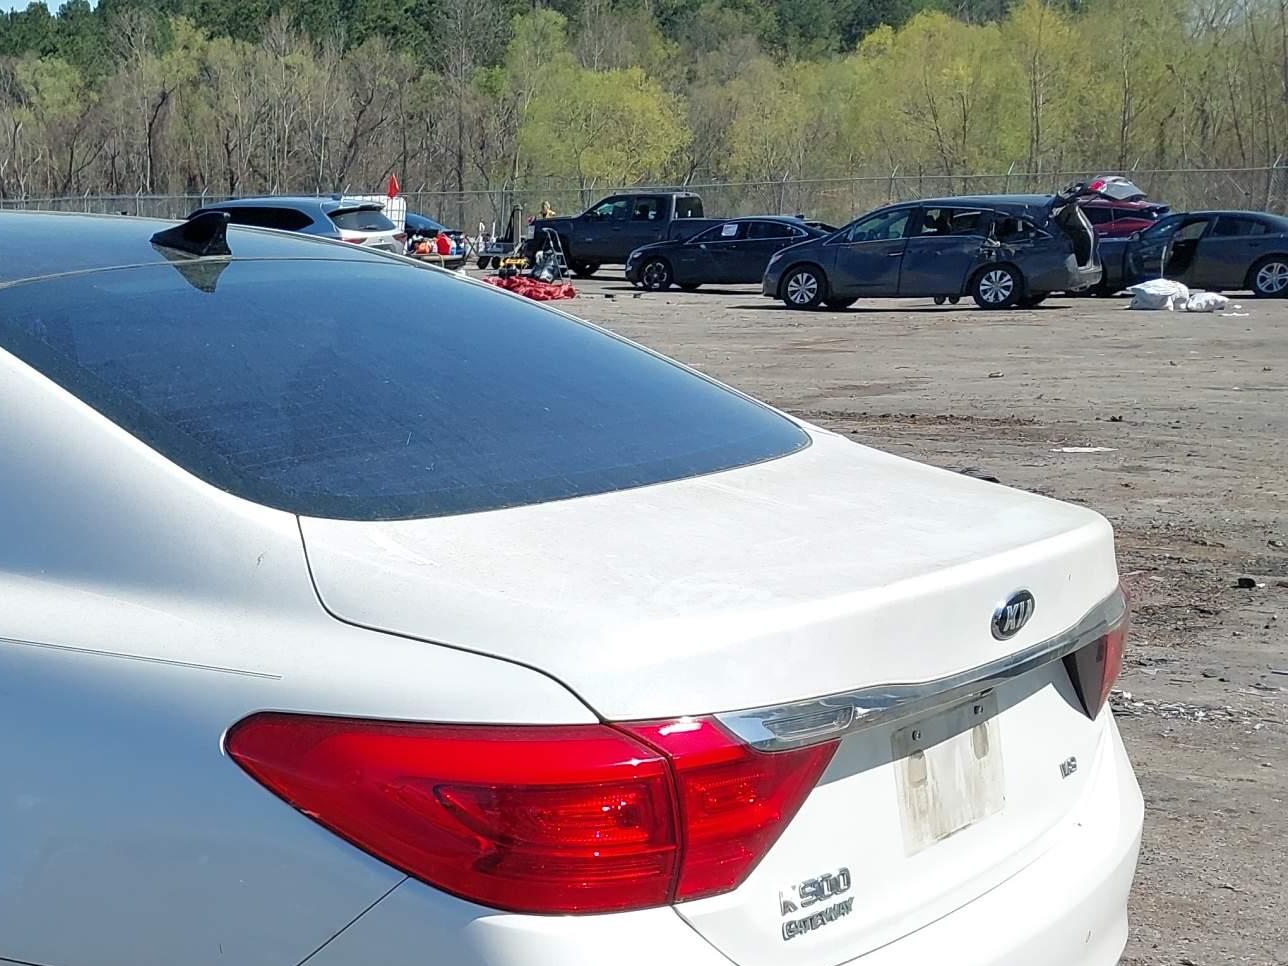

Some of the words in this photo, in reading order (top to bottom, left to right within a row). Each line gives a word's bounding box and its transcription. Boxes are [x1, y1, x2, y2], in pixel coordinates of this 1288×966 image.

[1002, 598, 1033, 632] KIA
[778, 866, 852, 917] K900
[781, 896, 855, 941] GATEWAY
